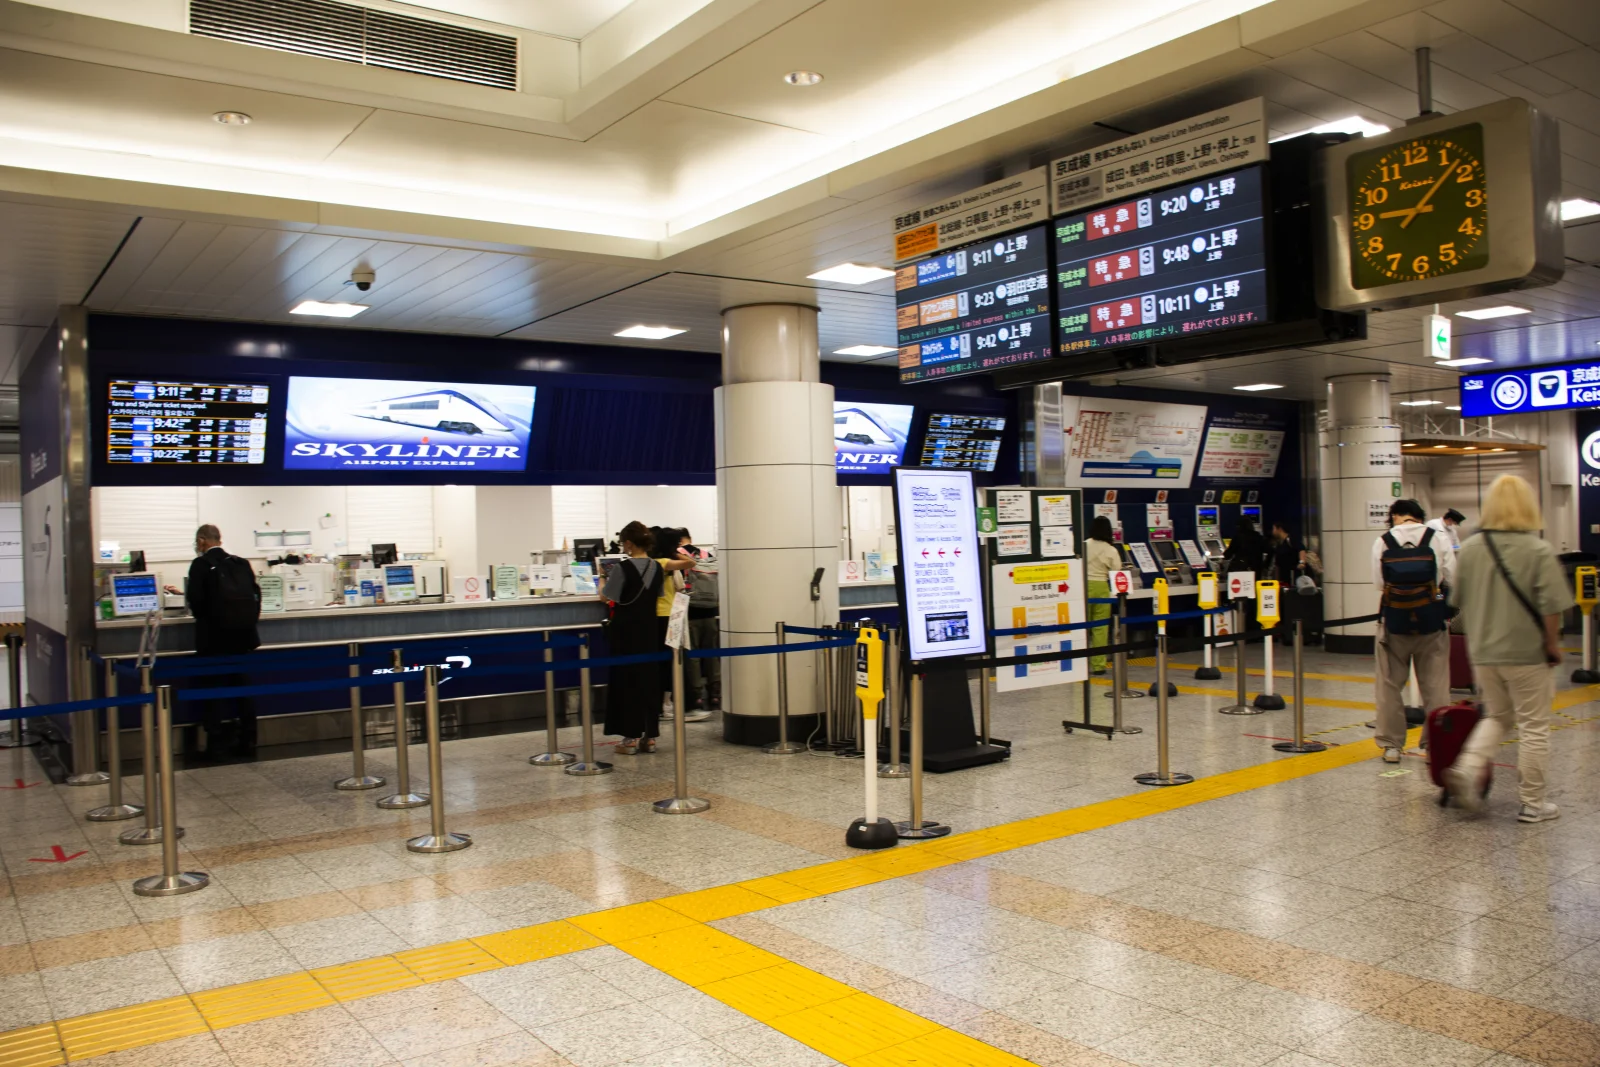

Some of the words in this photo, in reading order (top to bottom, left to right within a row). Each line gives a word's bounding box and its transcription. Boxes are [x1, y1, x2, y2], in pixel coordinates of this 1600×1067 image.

[1056, 153, 1091, 177] 京成線
[1150, 131, 1171, 144] Keisei
[1172, 128, 1188, 138] Line
[1189, 115, 1230, 132] Information
[1402, 146, 1429, 167] 12
[1439, 149, 1450, 166] 1
[1116, 181, 1136, 191] Narita,
[1136, 170, 1170, 184] Funabashi,
[1380, 164, 1402, 183] 11
[1456, 164, 1473, 184] 2
[980, 190, 992, 200] Line
[992, 181, 1023, 197] Information
[1364, 187, 1389, 206] 10
[1465, 189, 1483, 207] 3
[1092, 208, 1129, 229] 特急
[1139, 201, 1150, 217] 3
[1161, 195, 1187, 216] 9:20
[1203, 177, 1236, 200] 上野
[1359, 213, 1375, 230] 9
[1457, 217, 1477, 235] 4
[972, 249, 992, 267] 9:11
[1004, 235, 1028, 254] 上野
[1094, 255, 1132, 275] 特急
[1141, 249, 1151, 264] 3
[1162, 244, 1190, 265] 9:48
[1205, 228, 1238, 251] 上野
[1367, 237, 1384, 253] 8
[1439, 242, 1456, 261] 5
[1386, 253, 1402, 271] 7
[1412, 255, 1429, 273] 6
[974, 291, 995, 308] 9:23
[1005, 274, 1048, 297] 羽田空港
[1096, 303, 1134, 321] 特急
[1143, 297, 1154, 312] 3
[1158, 294, 1191, 315] 10:11
[1207, 279, 1240, 301] 上野
[962, 319, 982, 329] limited
[983, 314, 1004, 325] express
[1005, 309, 1024, 320] within
[1026, 307, 1036, 315] the
[976, 333, 997, 350] 9:42
[1008, 322, 1032, 340] 上野
[157, 386, 179, 397] 9:11
[138, 401, 163, 409] Skyliner
[163, 401, 180, 409] ticket
[154, 417, 179, 428] 9:42
[153, 433, 178, 444] 9:56
[153, 449, 179, 458] 10:22
[413, 459, 476, 467] EXPRESS
